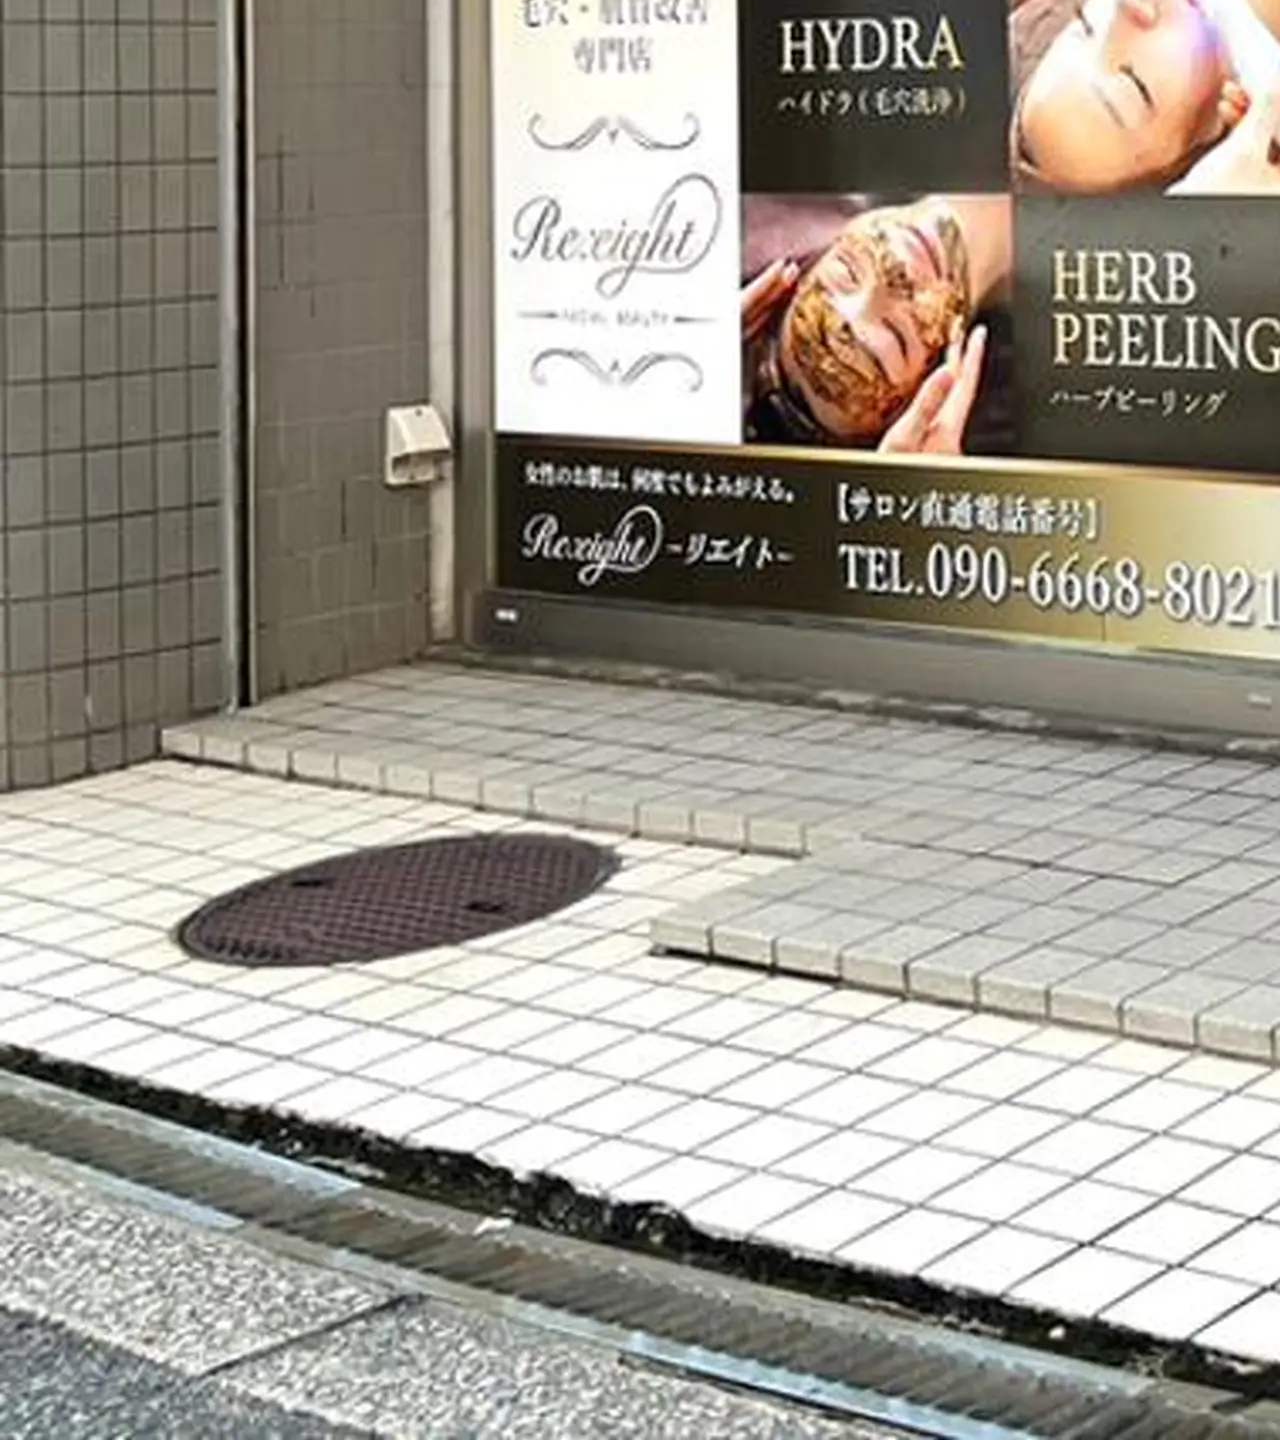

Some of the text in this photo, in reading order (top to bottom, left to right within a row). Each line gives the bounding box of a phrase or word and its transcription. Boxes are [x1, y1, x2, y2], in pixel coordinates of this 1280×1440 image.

[572, 35, 653, 75] 専門店
[779, 15, 967, 73] HYDRA
[1051, 247, 1199, 306] HERB
